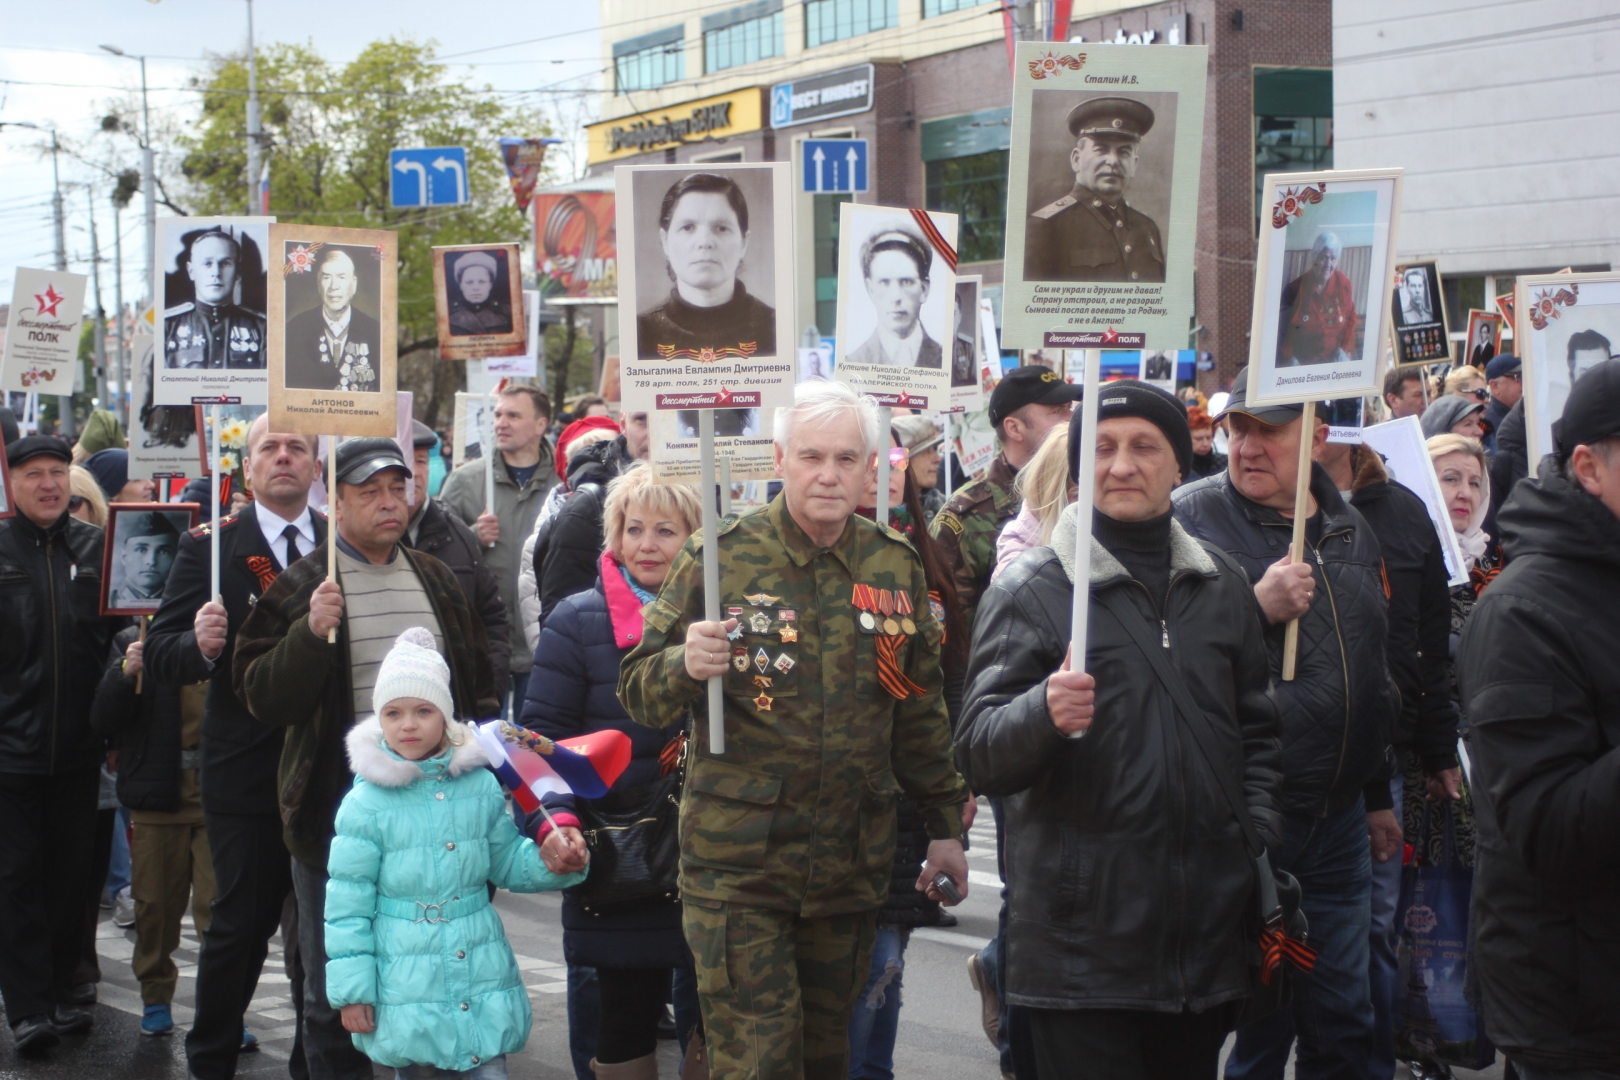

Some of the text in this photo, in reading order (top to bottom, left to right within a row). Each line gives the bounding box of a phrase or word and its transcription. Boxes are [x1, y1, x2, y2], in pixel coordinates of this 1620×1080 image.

[1084, 74, 1139, 85] Сталин И.В.
[690, 101, 732, 136] БАНК
[1034, 285, 1050, 294] Сам
[1061, 286, 1086, 295] украл
[1093, 286, 1123, 296] другим
[1134, 286, 1162, 295] давал!
[1032, 295, 1062, 305] Страну
[1063, 297, 1108, 305] отстроил,
[1126, 297, 1163, 306] разорил!
[1025, 305, 1060, 314] Сыновей
[1137, 307, 1168, 316] Родину,
[1091, 316, 1125, 325] Англию!
[28, 331, 59, 343] ПОЛК
[1118, 336, 1140, 344] ПОЛК
[626, 363, 791, 376] Залыгалина Евлампия Дмитриевна
[871, 364, 901, 374] Николай
[903, 367, 950, 378] Стефанович
[229, 376, 267, 384] Дмитриеви
[634, 380, 651, 388] 789
[744, 377, 782, 385] дивизия
[877, 374, 911, 382] РЯДОВОЙ
[1276, 370, 1362, 387] Данилова Евгения Сергеевна
[311, 399, 355, 407] АНТОНОВ
[732, 395, 756, 403] ПОЛК
[908, 398, 925, 406] ПОЛК
[286, 405, 379, 416] Николай Алексеевич
[666, 442, 698, 450] Конякин
[734, 439, 774, 447] Степанови
